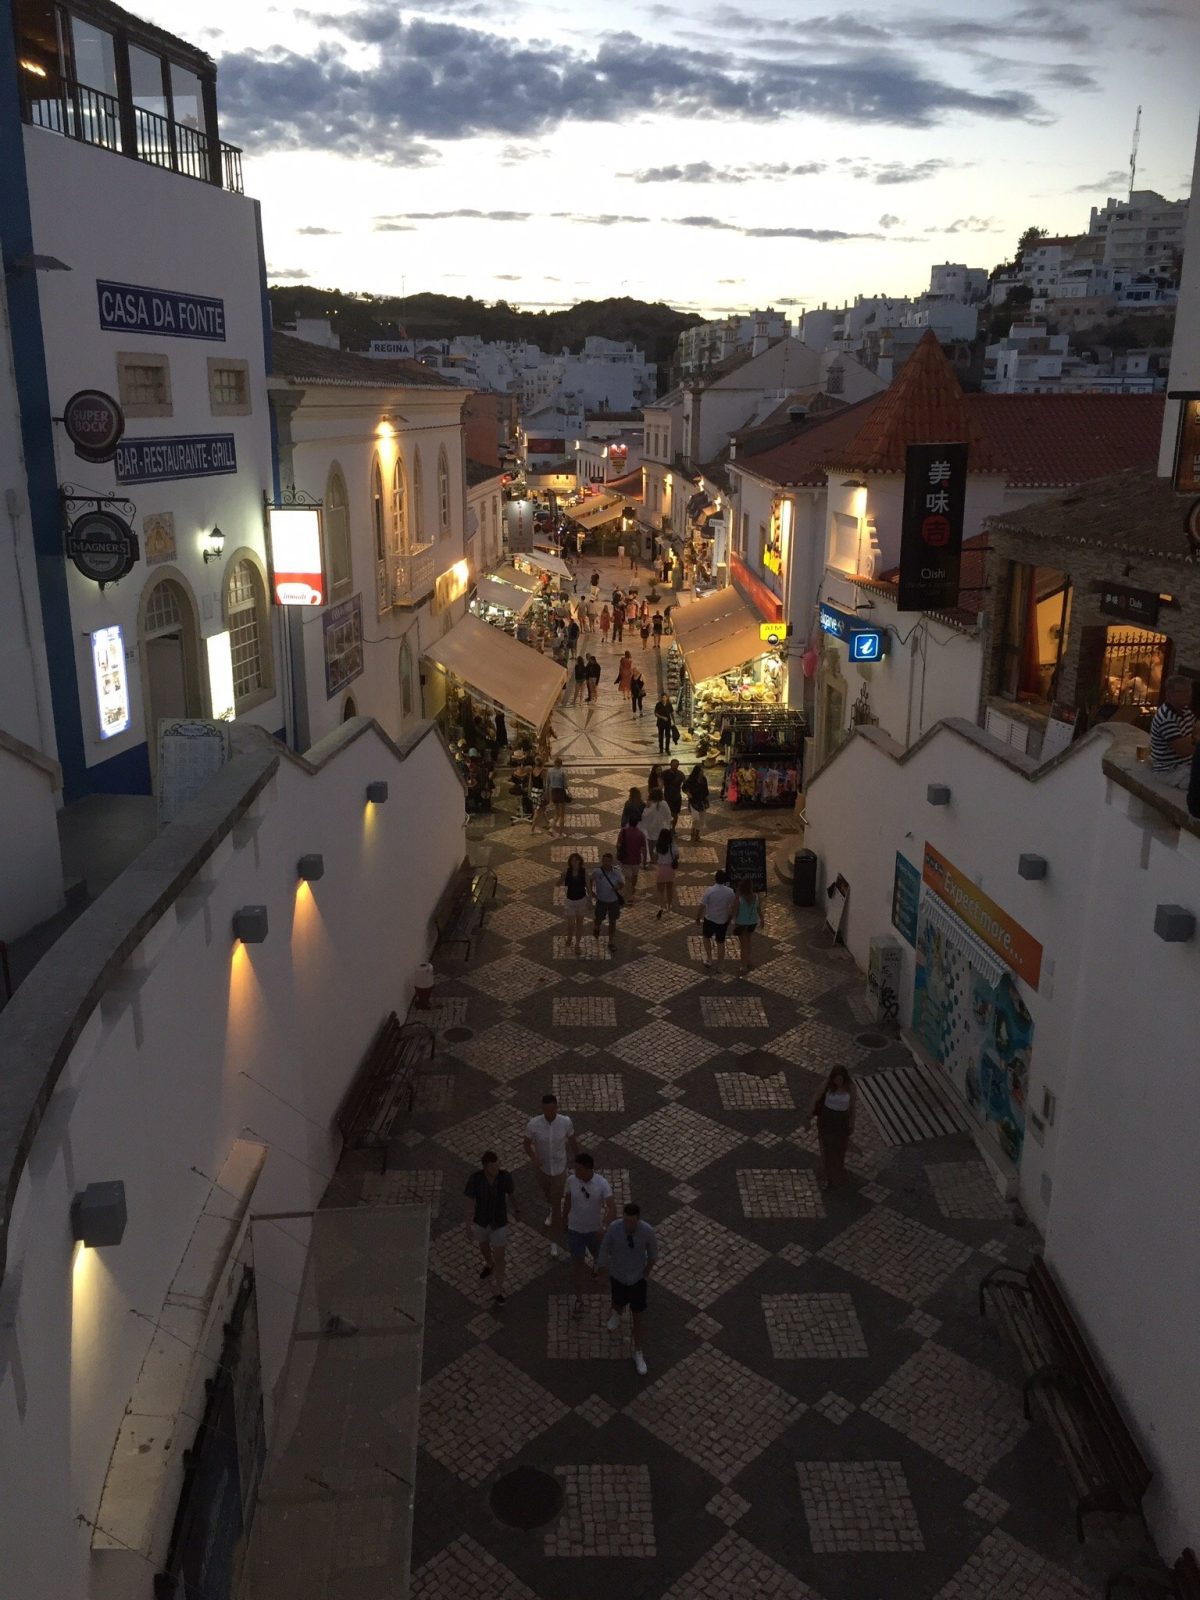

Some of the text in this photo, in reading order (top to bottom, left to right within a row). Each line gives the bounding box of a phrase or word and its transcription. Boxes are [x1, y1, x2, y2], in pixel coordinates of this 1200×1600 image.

[101, 291, 224, 333] CASA DA FONTE
[374, 344, 410, 353] REGINA
[73, 409, 109, 423] SUPER
[75, 420, 108, 434] BOCK
[71, 541, 127, 553] MAGNERS
[944, 871, 979, 921] Expect
